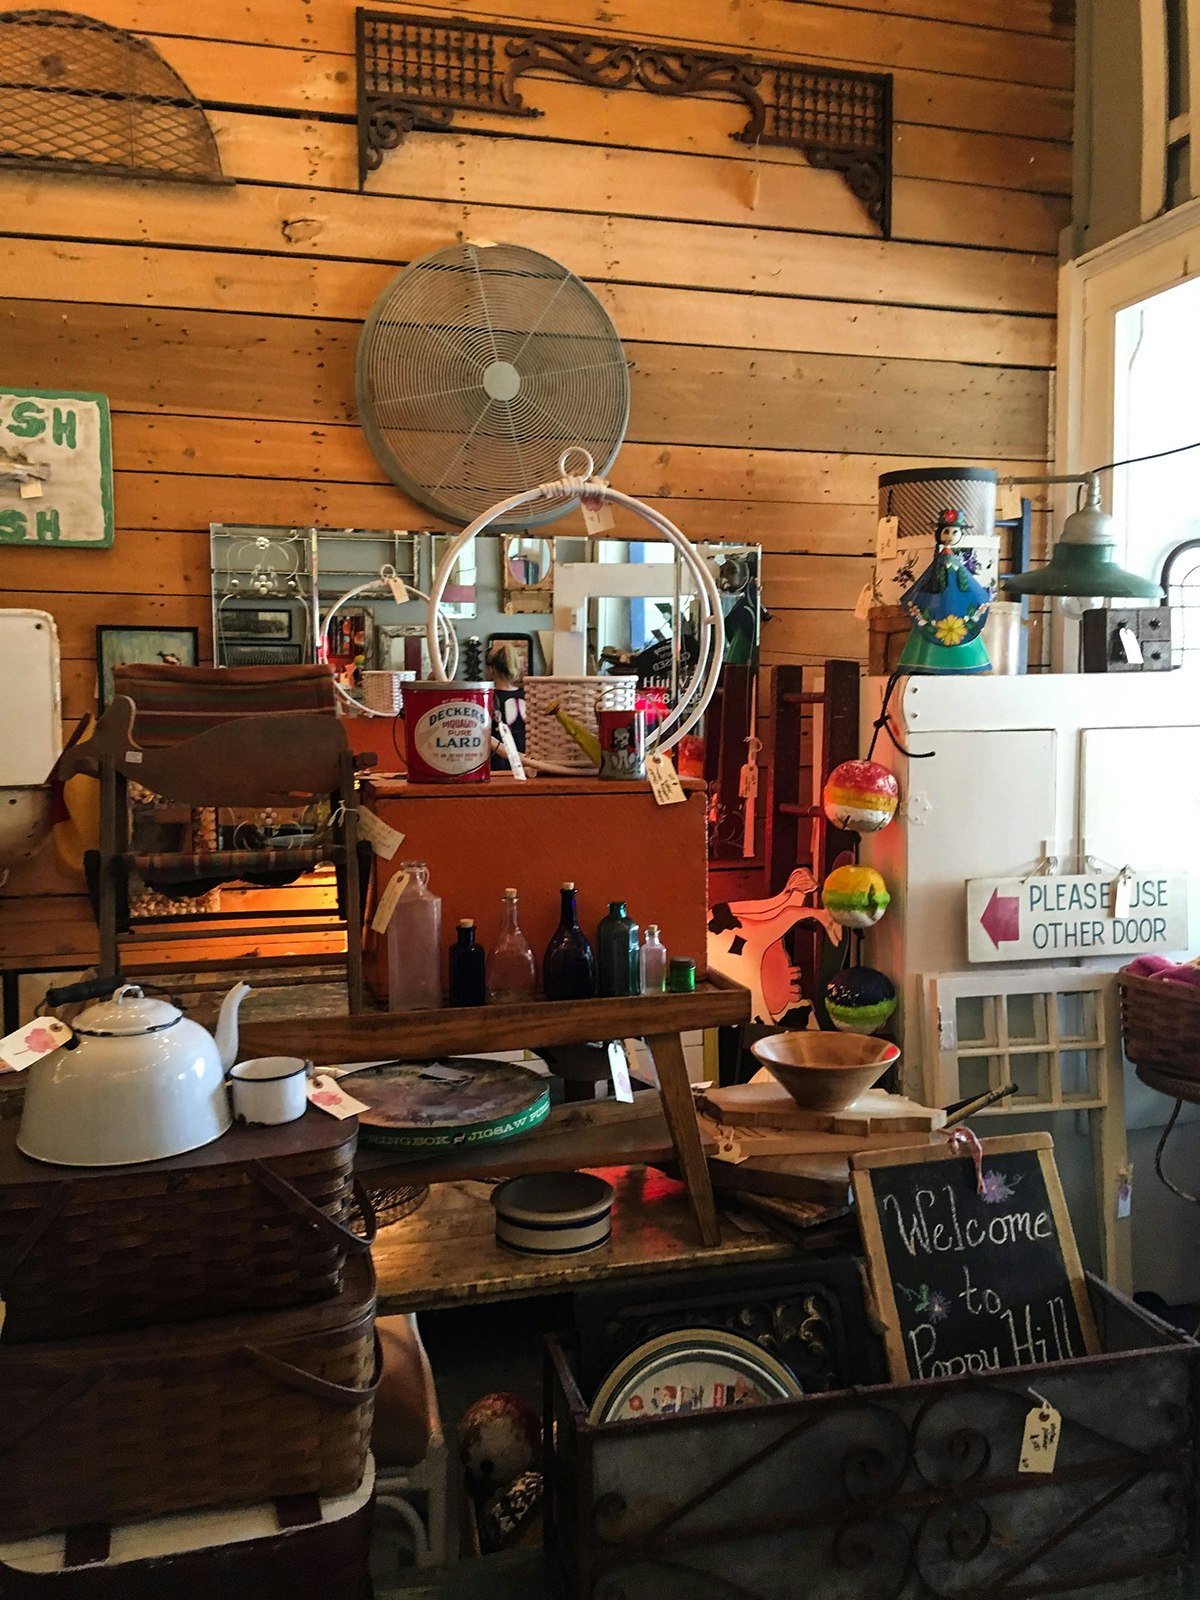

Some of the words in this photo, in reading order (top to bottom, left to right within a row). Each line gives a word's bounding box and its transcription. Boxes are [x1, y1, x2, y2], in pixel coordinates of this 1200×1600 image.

[0, 401, 77, 449] SH
[436, 738, 482, 748] LARD
[1029, 881, 1111, 912] PLEASE
[1033, 921, 1105, 950] OTHER
[1112, 918, 1167, 945] DOOR
[467, 1116, 527, 1142] JIGSAW
[883, 1185, 1052, 1257] Welcome
[958, 1265, 1003, 1315] to
[1000, 1296, 1074, 1368] Hill
